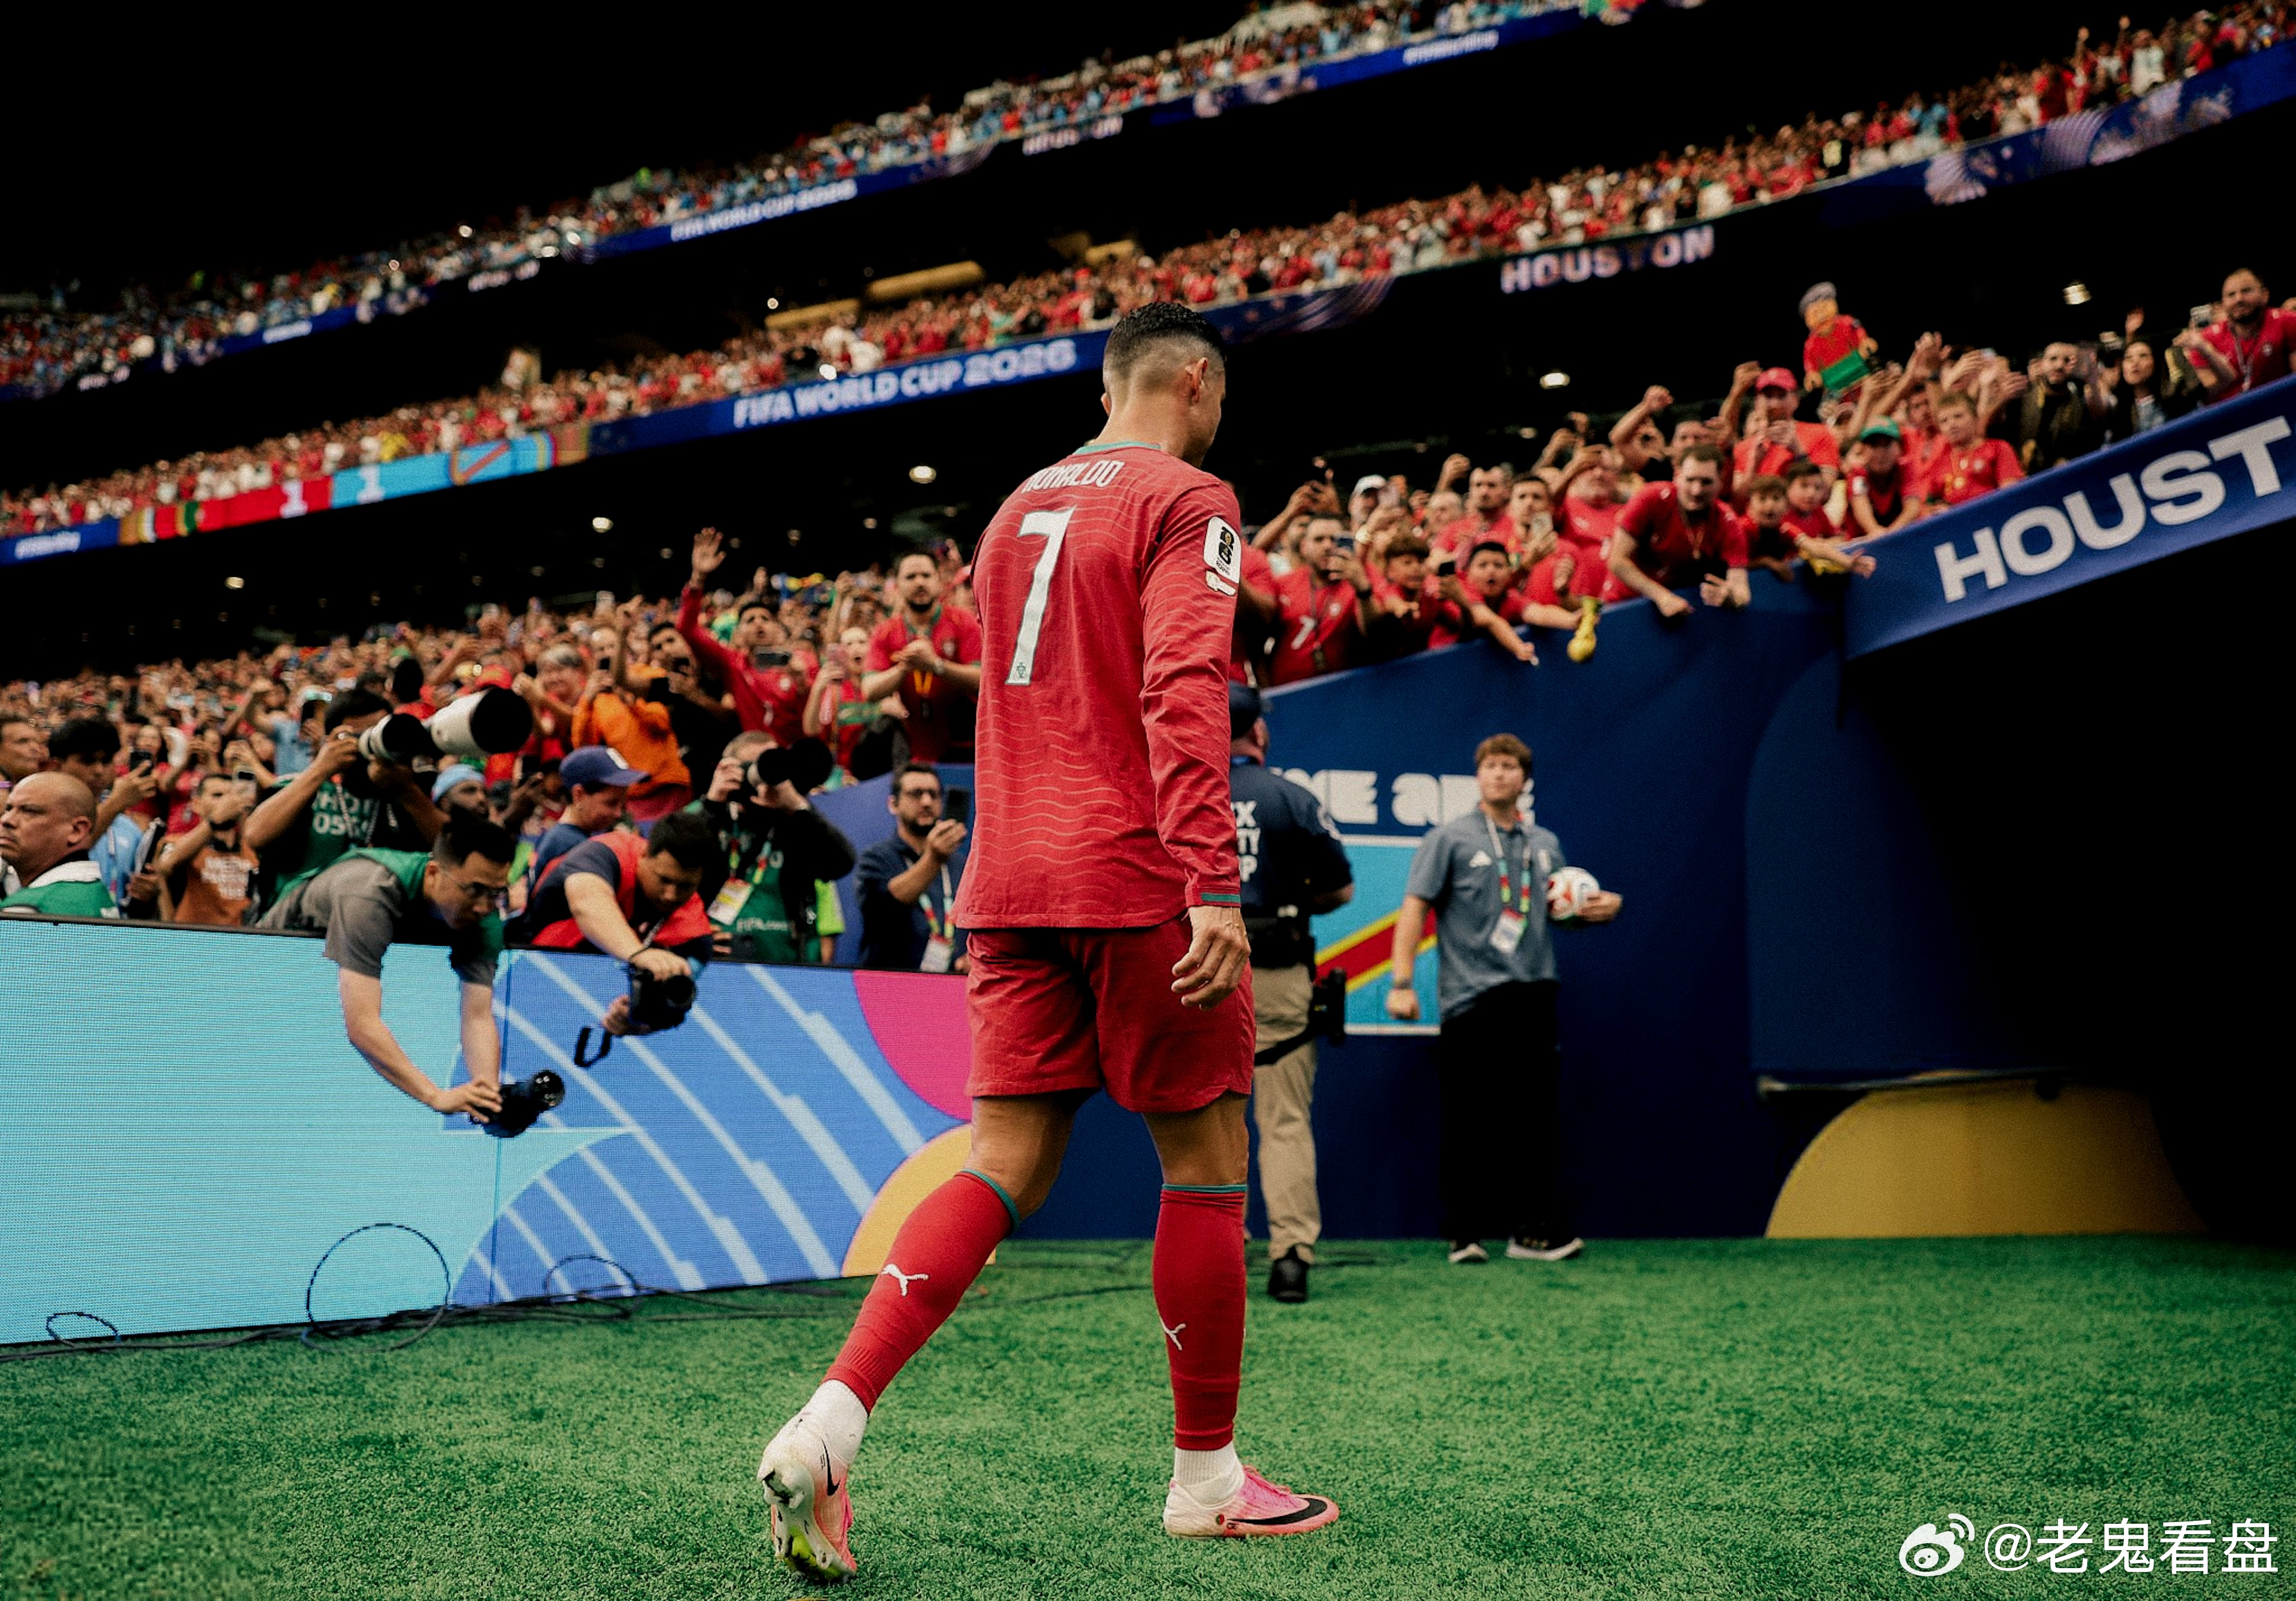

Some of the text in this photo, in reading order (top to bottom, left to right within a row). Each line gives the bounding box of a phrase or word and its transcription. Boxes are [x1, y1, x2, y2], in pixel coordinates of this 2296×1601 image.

[733, 338, 1076, 428] FIFA WORLD CUP 2026
[279, 463, 386, 519] 1 1
[1021, 460, 1125, 494] RONALDO
[1934, 415, 2292, 603] HOUST
[1004, 505, 1076, 686] 7
